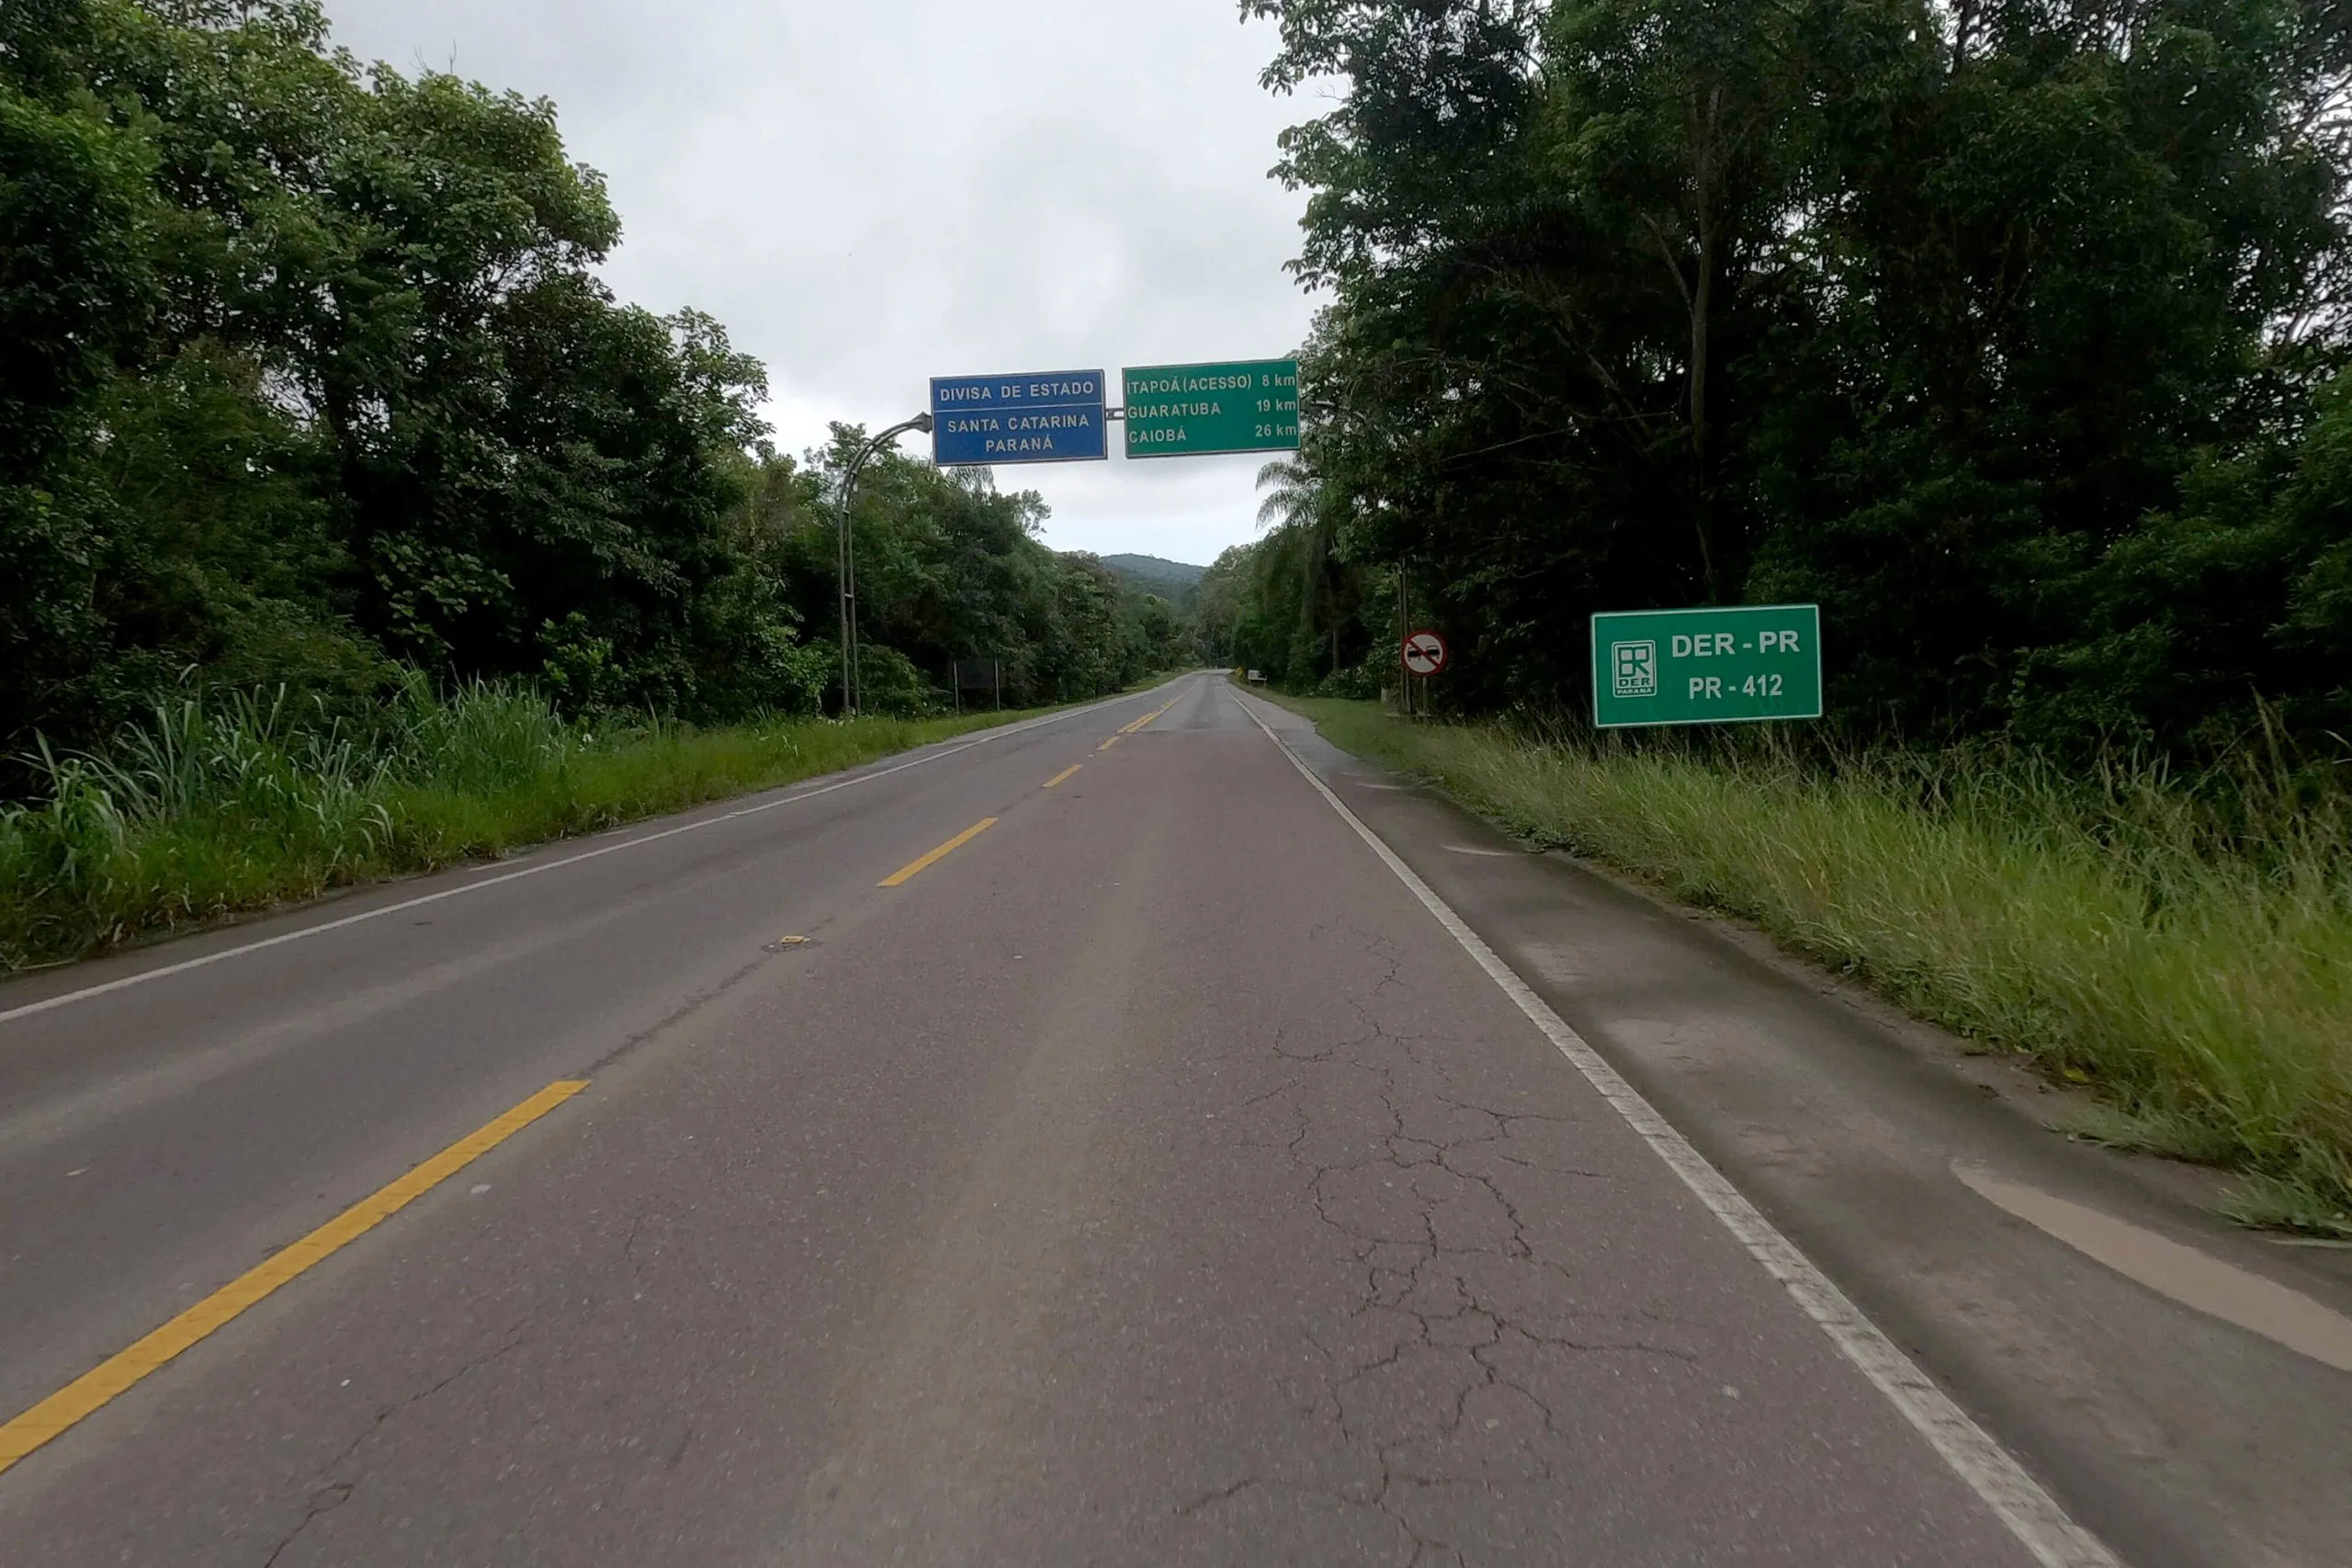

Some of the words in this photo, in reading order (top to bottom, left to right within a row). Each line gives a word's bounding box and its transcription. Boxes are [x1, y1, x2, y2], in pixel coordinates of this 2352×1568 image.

[1262, 375, 1270, 387] 8
[1274, 374, 1295, 387] km
[940, 387, 992, 401] DIVISA
[1001, 385, 1022, 398] DE
[1030, 381, 1093, 397] ESTADO
[1127, 402, 1221, 419] GUARATUBA
[1256, 400, 1271, 412] 19
[1275, 399, 1296, 412] km
[947, 419, 1000, 433] SANTA
[1008, 414, 1090, 430] CATARINA
[1128, 425, 1186, 443] CAIOBÁ
[1255, 424, 1272, 437] 26
[1276, 423, 1296, 436] km
[986, 434, 1053, 452] PARANÁ
[1619, 677, 1650, 687] DER
[1742, 674, 1782, 696] 412
